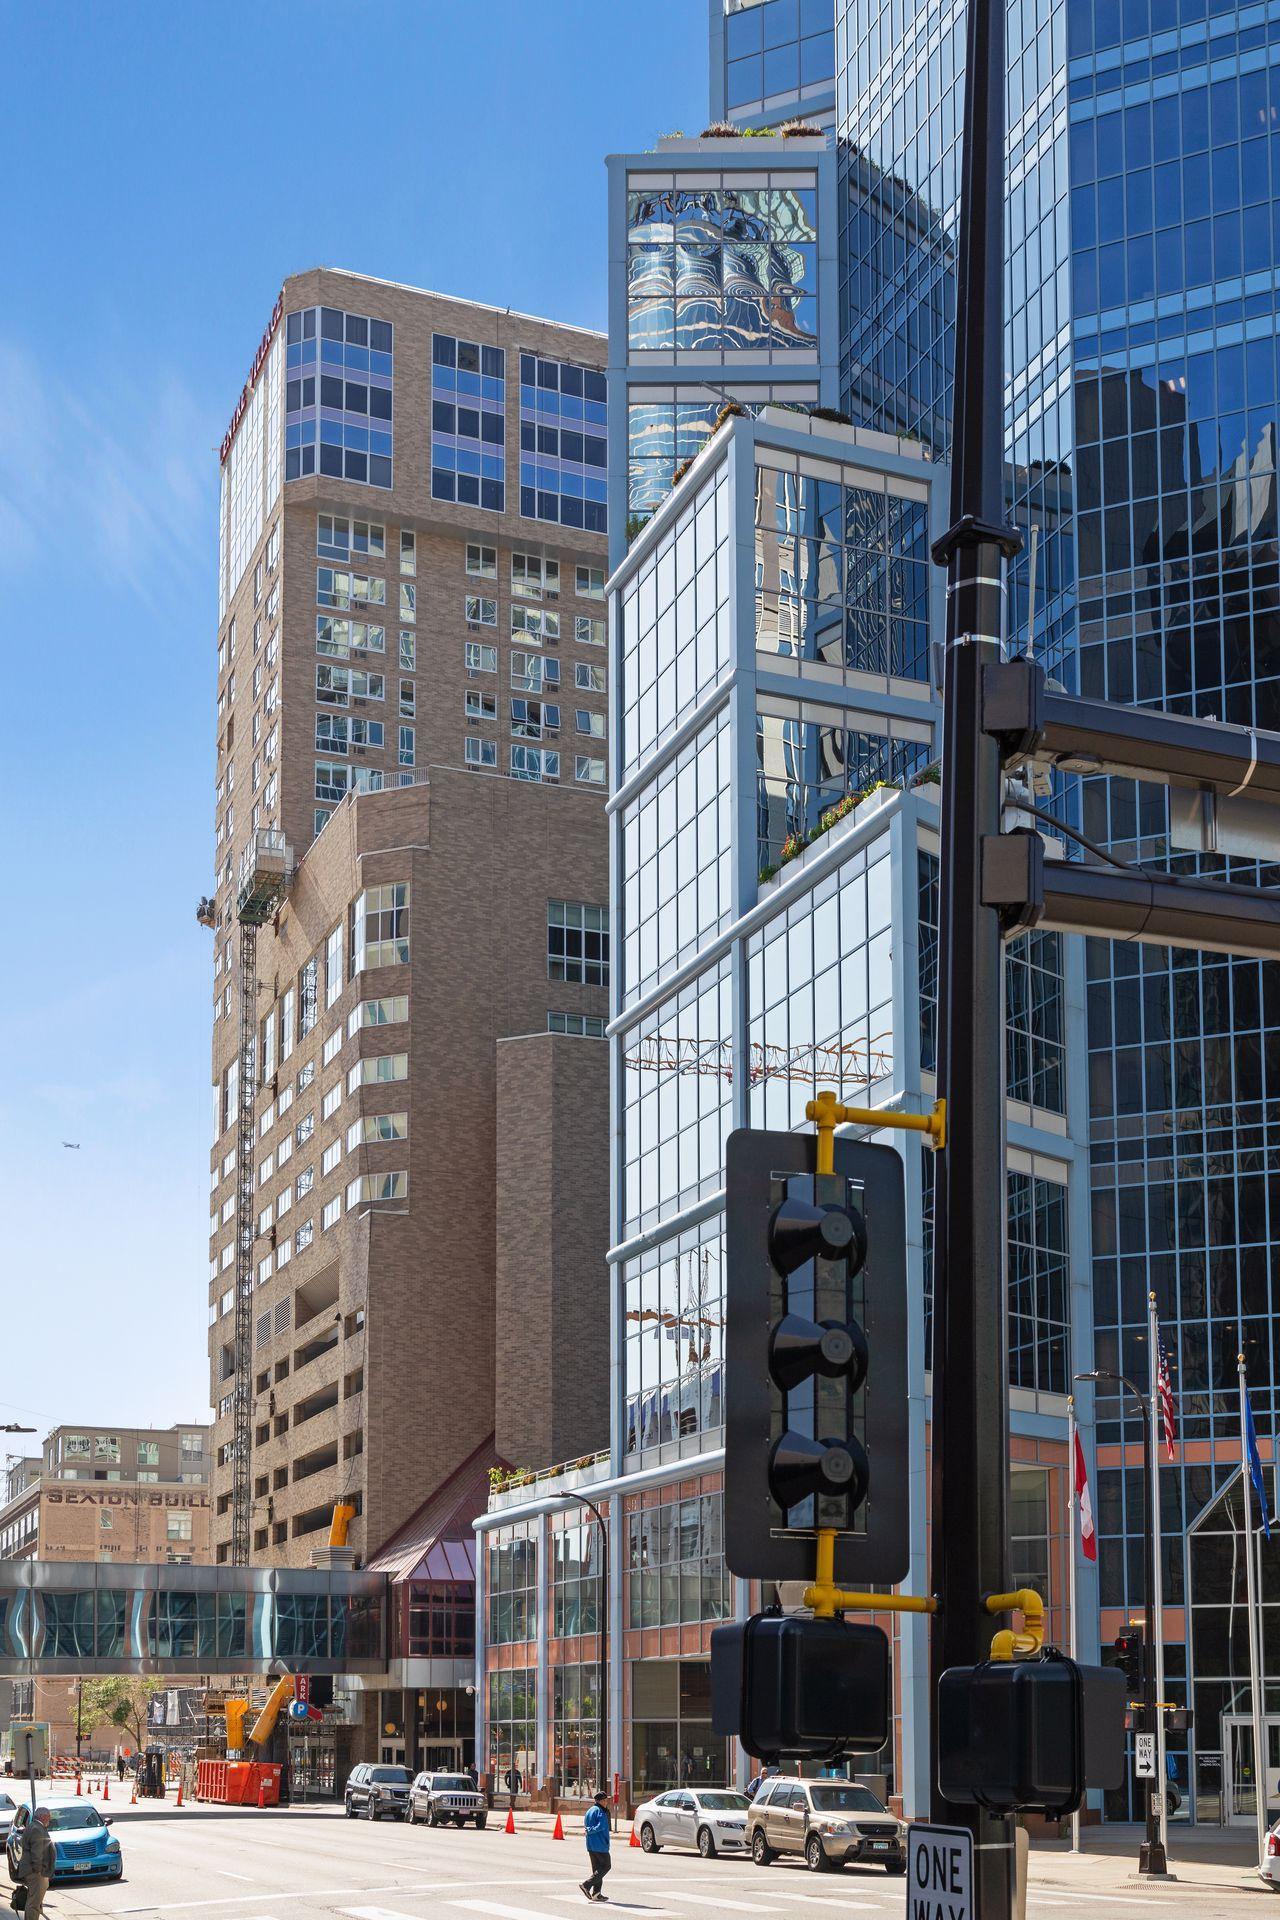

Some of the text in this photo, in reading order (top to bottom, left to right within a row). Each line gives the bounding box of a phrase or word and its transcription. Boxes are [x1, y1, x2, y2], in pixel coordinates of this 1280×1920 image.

[48, 1488, 137, 1505] SEXTON
[298, 1704, 305, 1714] P
[1139, 1738, 1151, 1748] ONE
[1139, 1749, 1152, 1758] WAY
[917, 1843, 963, 1894] ONE
